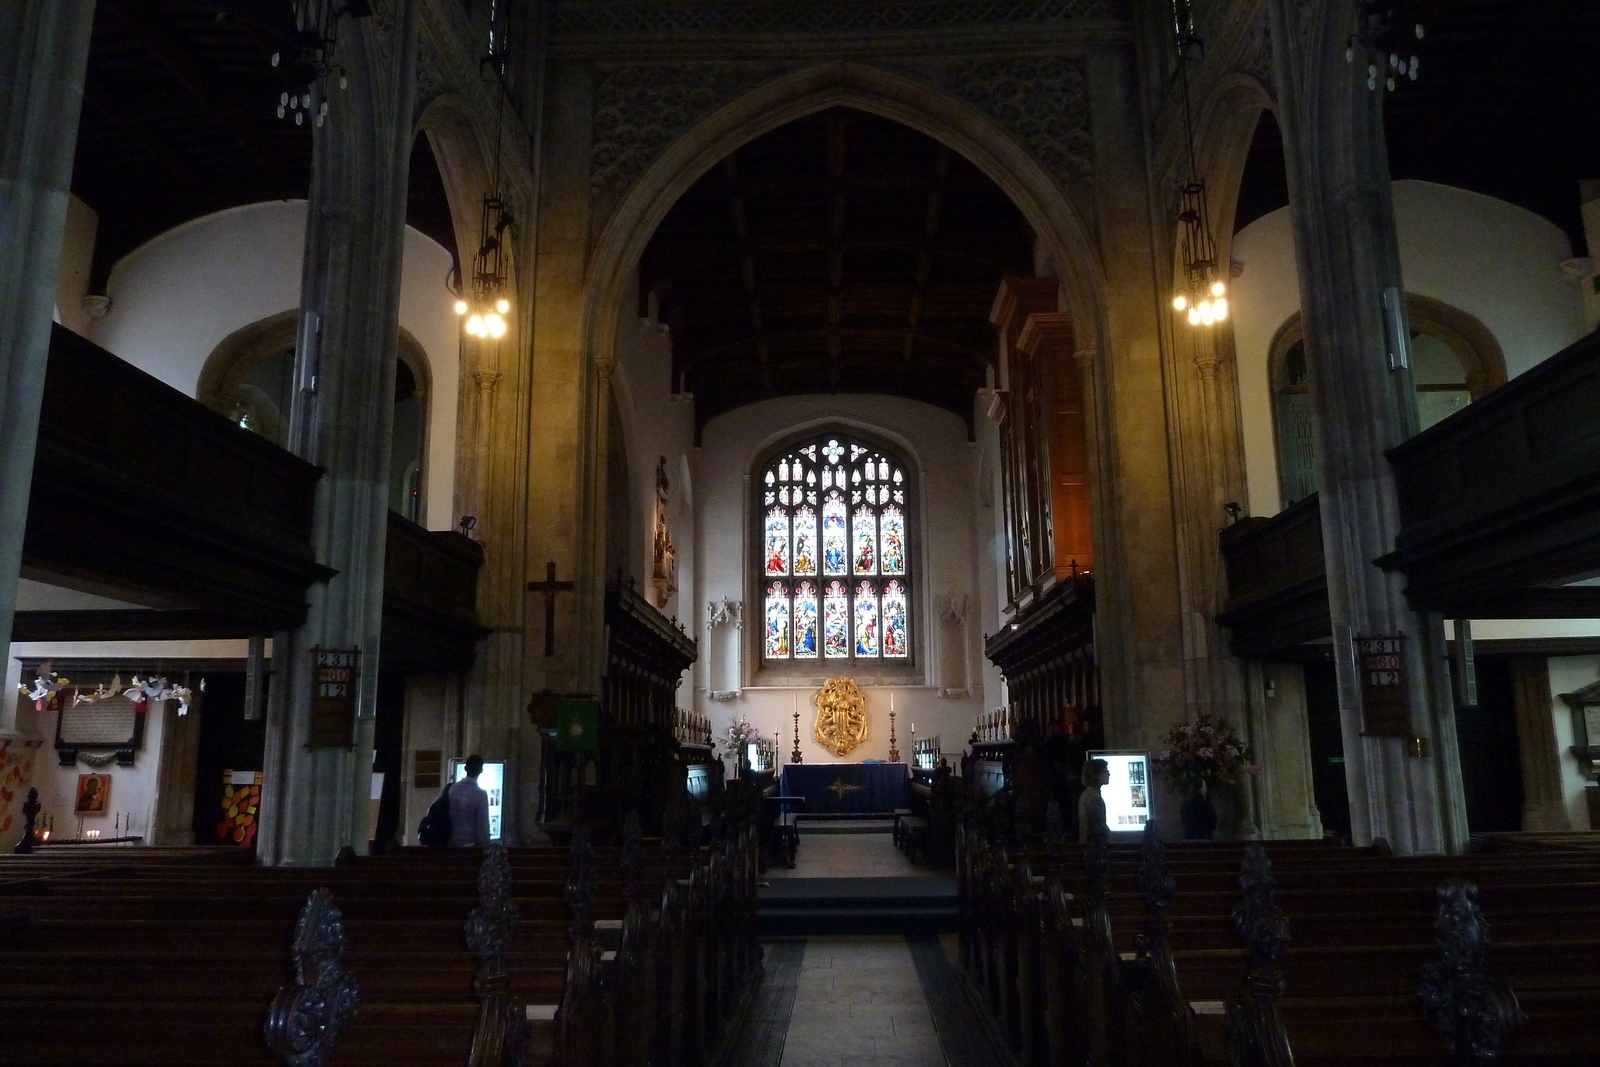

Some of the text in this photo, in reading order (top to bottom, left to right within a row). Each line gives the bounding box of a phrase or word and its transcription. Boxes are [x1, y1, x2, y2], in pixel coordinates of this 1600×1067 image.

[1363, 641, 1396, 653] 231
[320, 653, 350, 667] 231
[1375, 672, 1396, 685] 12
[324, 684, 344, 697] 12
